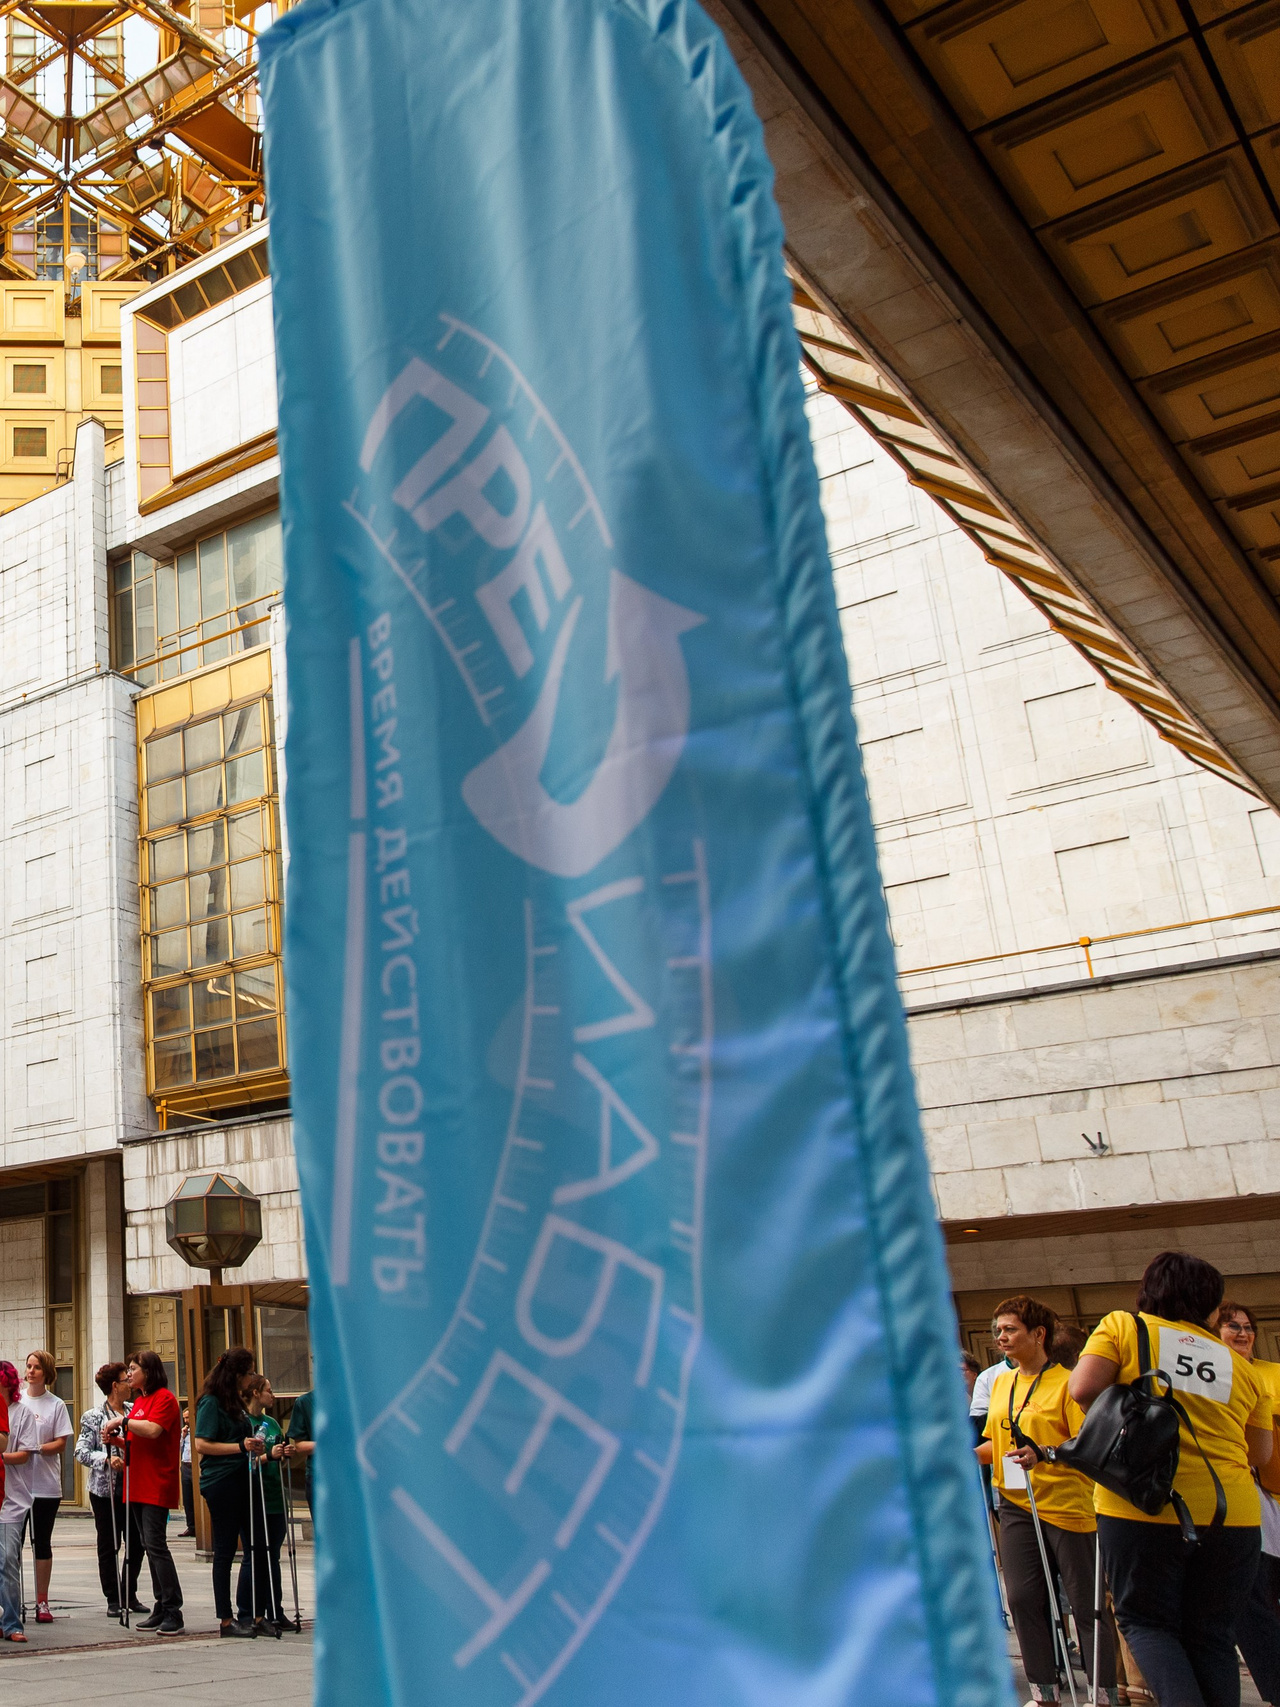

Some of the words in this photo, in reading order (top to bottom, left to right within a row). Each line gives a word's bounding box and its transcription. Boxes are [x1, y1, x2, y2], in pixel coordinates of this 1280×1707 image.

[367, 611, 404, 809] ВРЕМЯ
[372, 826, 426, 1295] ДЕЙСТВОВАТЬ
[1175, 1353, 1216, 1383] 56
